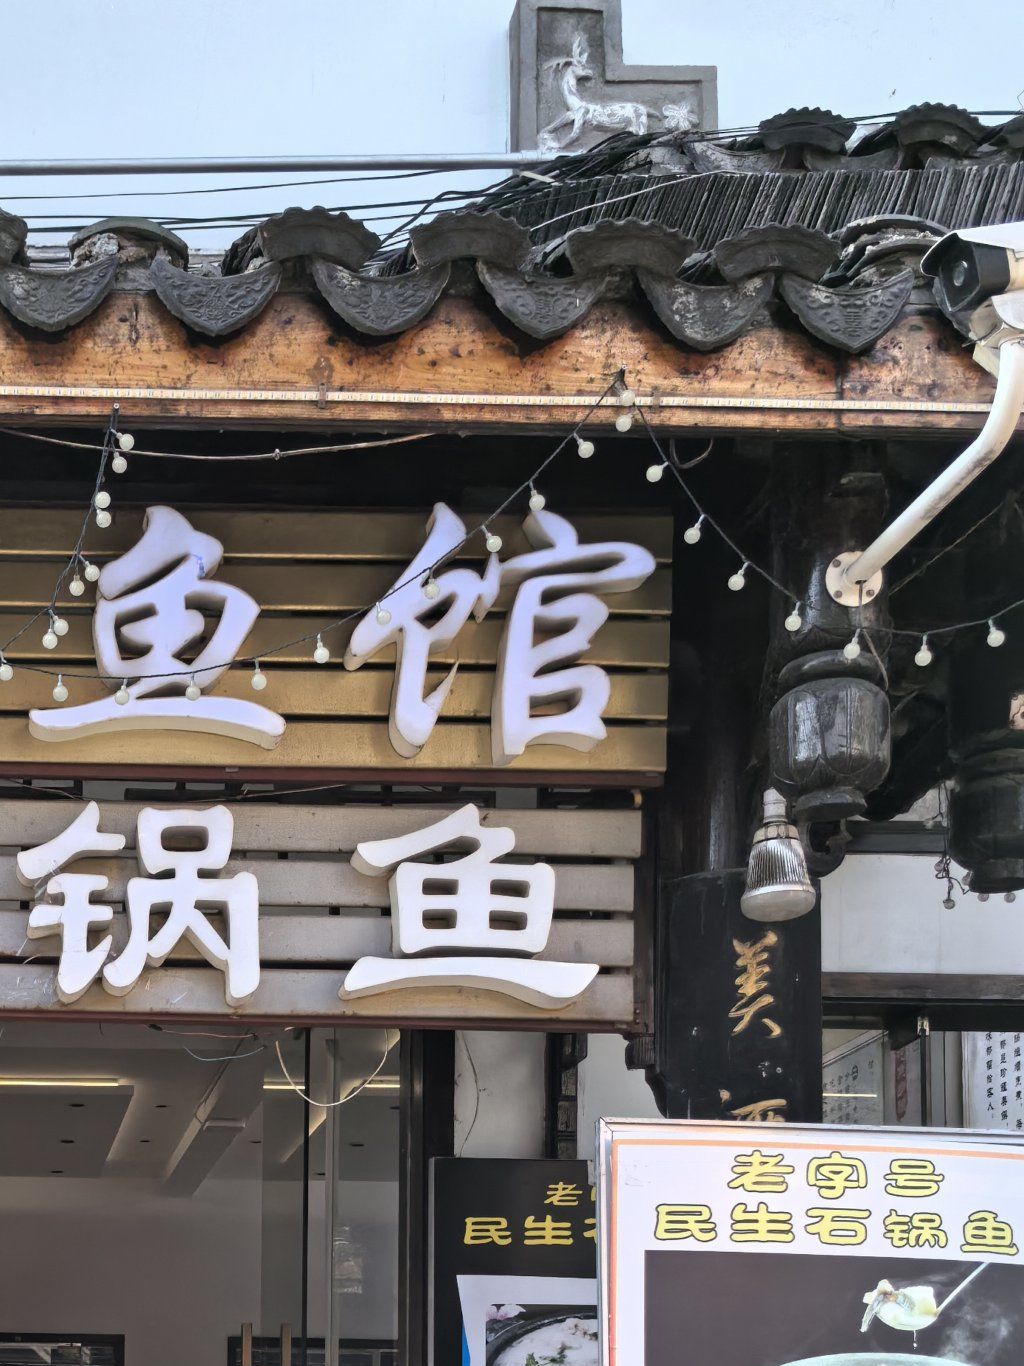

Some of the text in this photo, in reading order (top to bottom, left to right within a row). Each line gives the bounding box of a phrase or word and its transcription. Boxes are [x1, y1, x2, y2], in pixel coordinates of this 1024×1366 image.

[543, 1180, 596, 1206] 老
[727, 1149, 945, 1200] 老字号
[654, 1202, 1019, 1256] 民生石锅鱼
